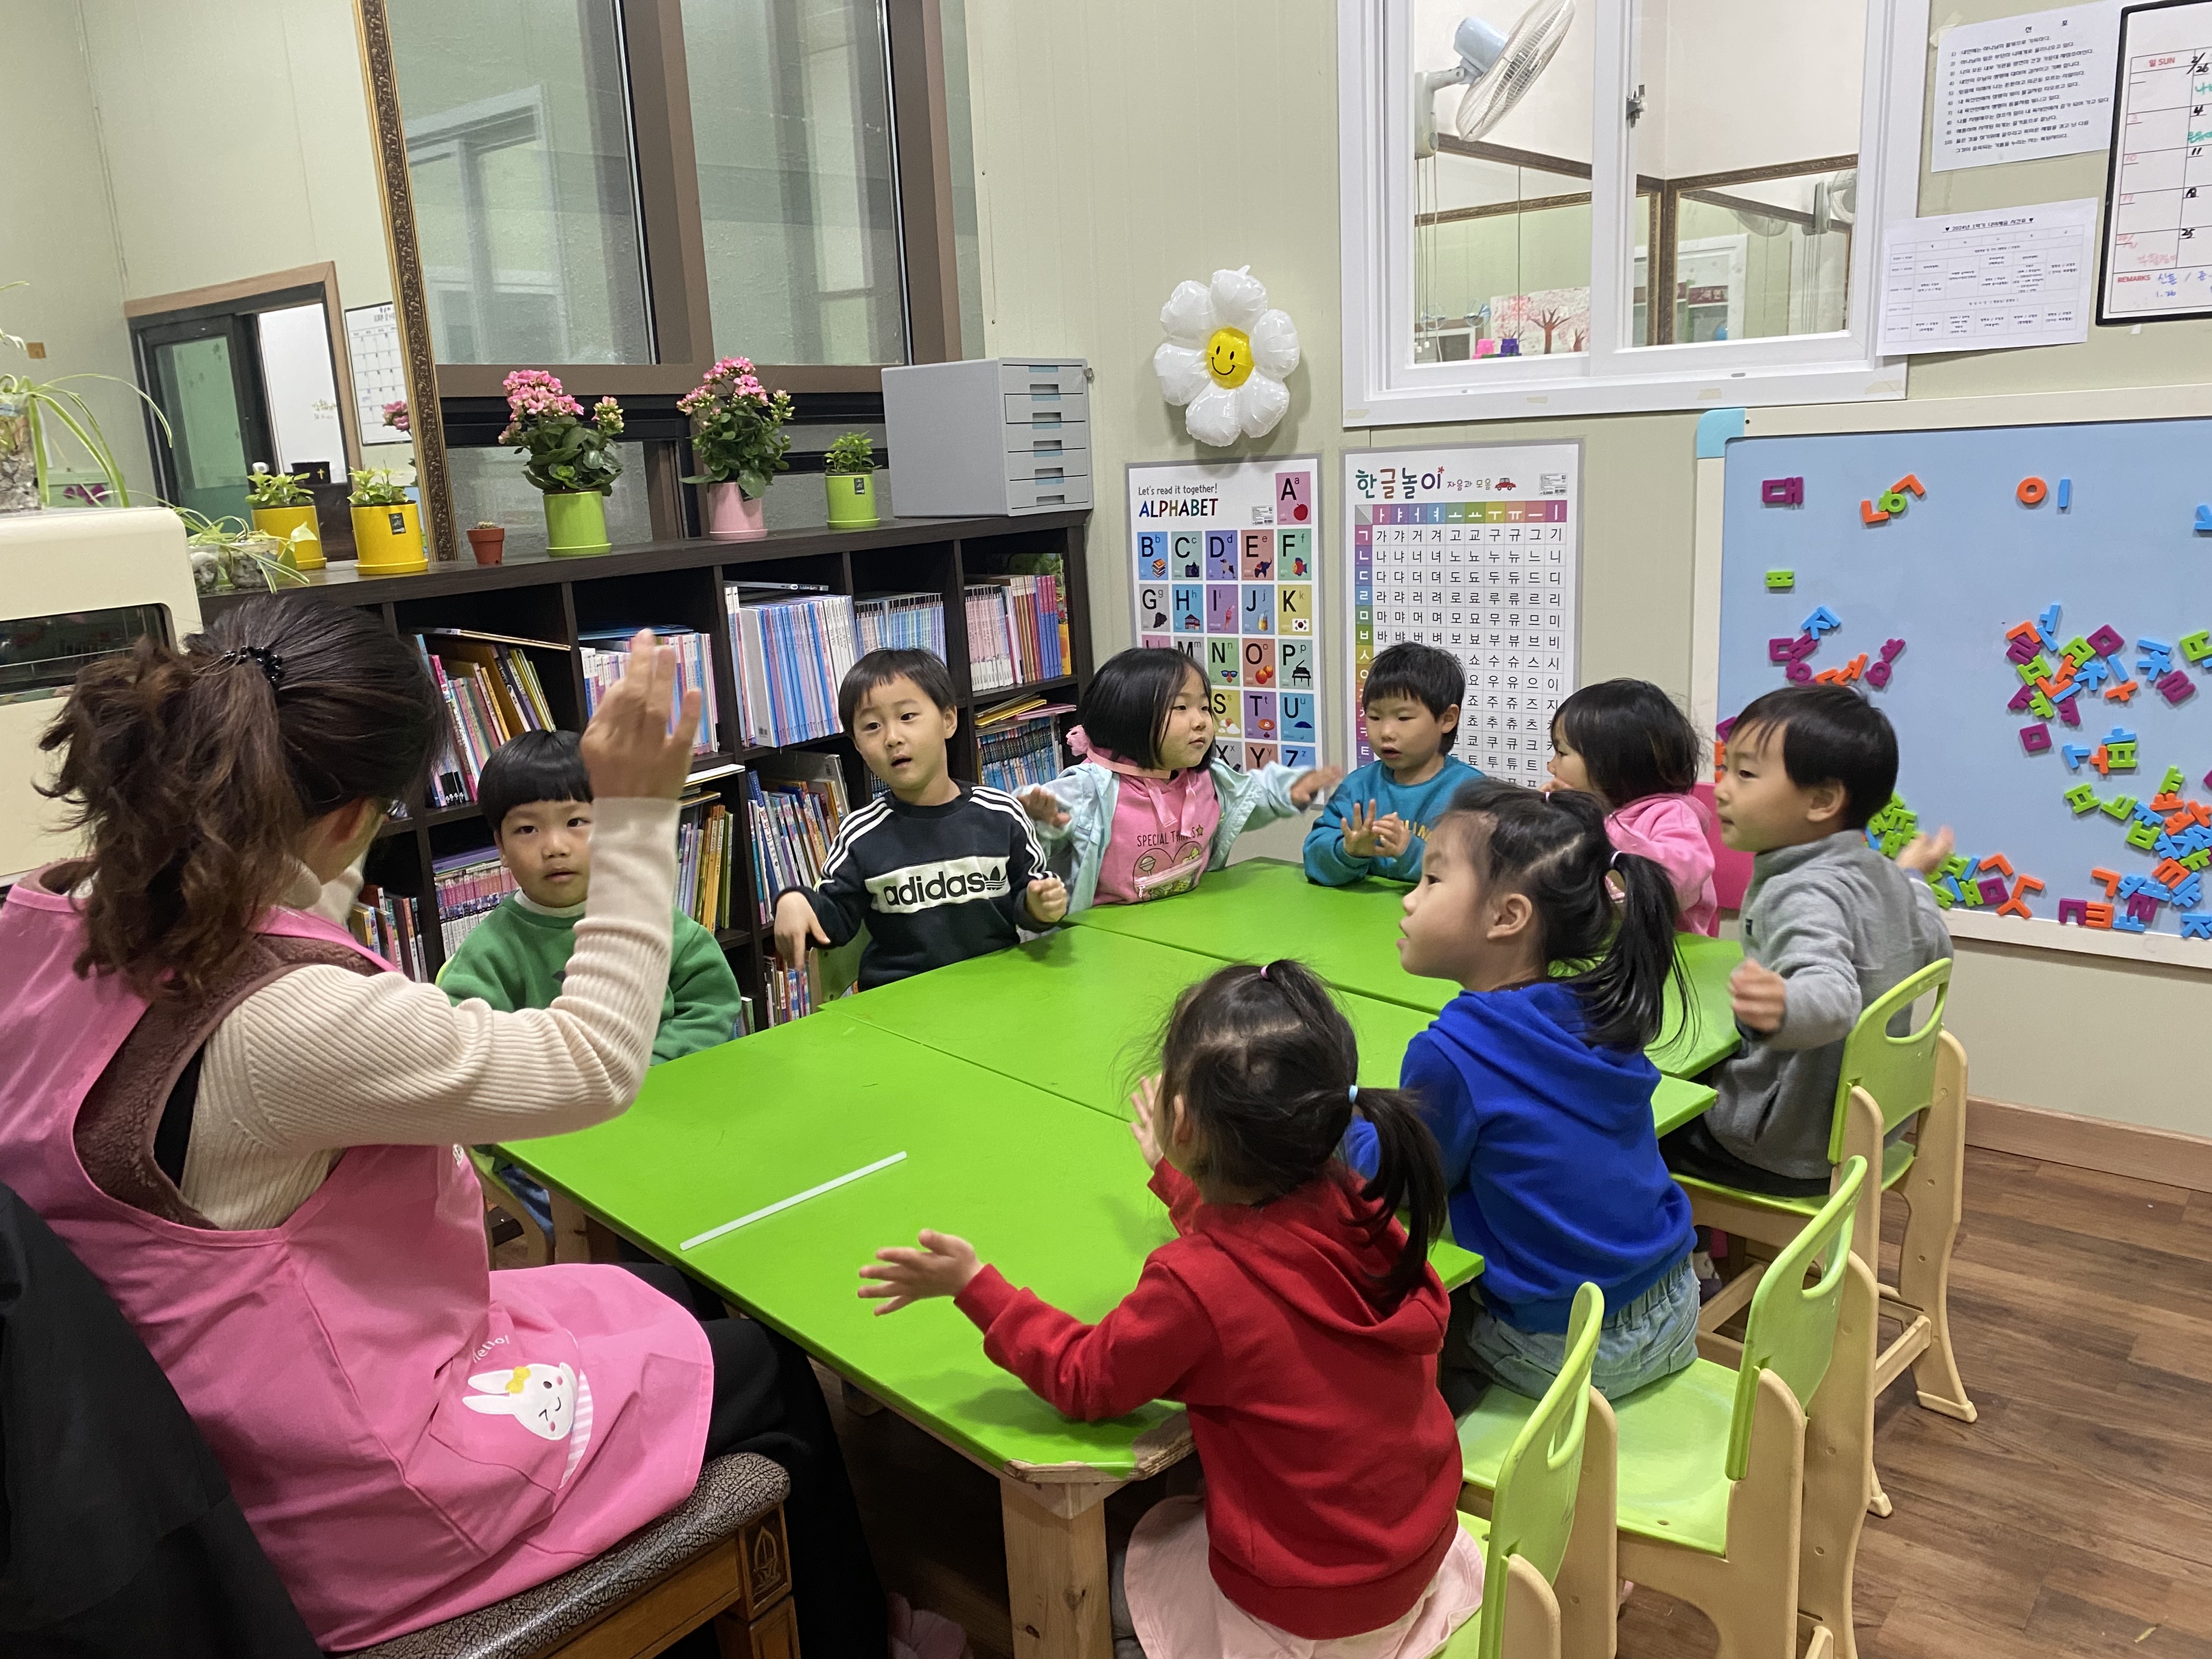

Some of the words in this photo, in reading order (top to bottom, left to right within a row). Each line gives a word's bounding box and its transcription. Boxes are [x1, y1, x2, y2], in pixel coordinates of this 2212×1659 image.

[2158, 57, 2175, 66] SUN
[2193, 105, 2203, 116] 4
[2181, 228, 2195, 239] 25
[2118, 274, 2151, 283] REMARKS
[1139, 486, 1154, 495] Let's
[1157, 486, 1172, 494] read
[1183, 483, 1217, 494] together!
[1356, 467, 1441, 499] 한글놀이
[1447, 479, 1472, 491] 자음과
[1476, 478, 1491, 490] 모음
[1139, 499, 1218, 517] ALPHABET
[1377, 531, 1386, 542] 가
[1395, 531, 1404, 542] 갸
[1413, 530, 1421, 542] 거
[1432, 530, 1441, 542] 겨
[1450, 531, 1461, 540] 고
[1469, 530, 1480, 540] 교
[1489, 529, 1500, 541] 구
[1509, 529, 1520, 541] 규
[1530, 529, 1541, 539] 그
[1551, 528, 1561, 541] 기
[1377, 551, 1386, 563] 나
[1395, 551, 1404, 563] 냐
[1413, 551, 1421, 563] 너
[1432, 551, 1440, 563] 녀
[1450, 551, 1460, 561] 노
[1469, 551, 1480, 561] 뇨
[1489, 551, 1500, 563] 누
[1509, 551, 1520, 563] 뉴
[1529, 551, 1541, 561] 느
[1550, 550, 1560, 563] 니
[1377, 571, 1386, 583] 다
[1395, 572, 1404, 583] 댜
[1413, 572, 1421, 583] 더
[1432, 572, 1441, 583] 뎌
[1451, 572, 1461, 582] 도
[1469, 572, 1480, 582] 됴
[1489, 572, 1499, 584] 두
[1509, 572, 1520, 584] 듀
[1528, 573, 1540, 583] 드
[1550, 572, 1560, 585] 디
[1377, 591, 1386, 603] 라
[1395, 591, 1404, 603] 랴
[1413, 592, 1422, 603] 러
[1432, 592, 1441, 604] 려
[1451, 592, 1462, 602] 로
[1469, 593, 1480, 603] 료
[1489, 593, 1500, 605] 루
[1509, 593, 1520, 605] 류
[1529, 594, 1540, 604] 르
[1550, 594, 1560, 606] 리
[1378, 611, 1387, 623] 마
[1395, 612, 1404, 623] 먀
[1414, 612, 1422, 624] 머
[1433, 613, 1441, 624] 며
[1451, 613, 1462, 623] 모
[1470, 613, 1480, 624] 묘
[1489, 614, 1500, 625] 무
[1509, 614, 1520, 626] 뮤
[1529, 615, 1540, 625] 므
[1550, 615, 1559, 628] 미
[1378, 631, 1387, 642] 바
[1414, 632, 1422, 644] 버
[1433, 633, 1441, 644] 벼
[1451, 634, 1462, 644] 보
[1470, 634, 1480, 644] 뵤
[1489, 634, 1500, 646] 부
[1509, 635, 1519, 647] 뷰
[1528, 636, 1539, 646] 브
[1550, 636, 1559, 649] 비
[1137, 833, 1169, 847] SPECIAL
[884, 871, 985, 905] adidas
